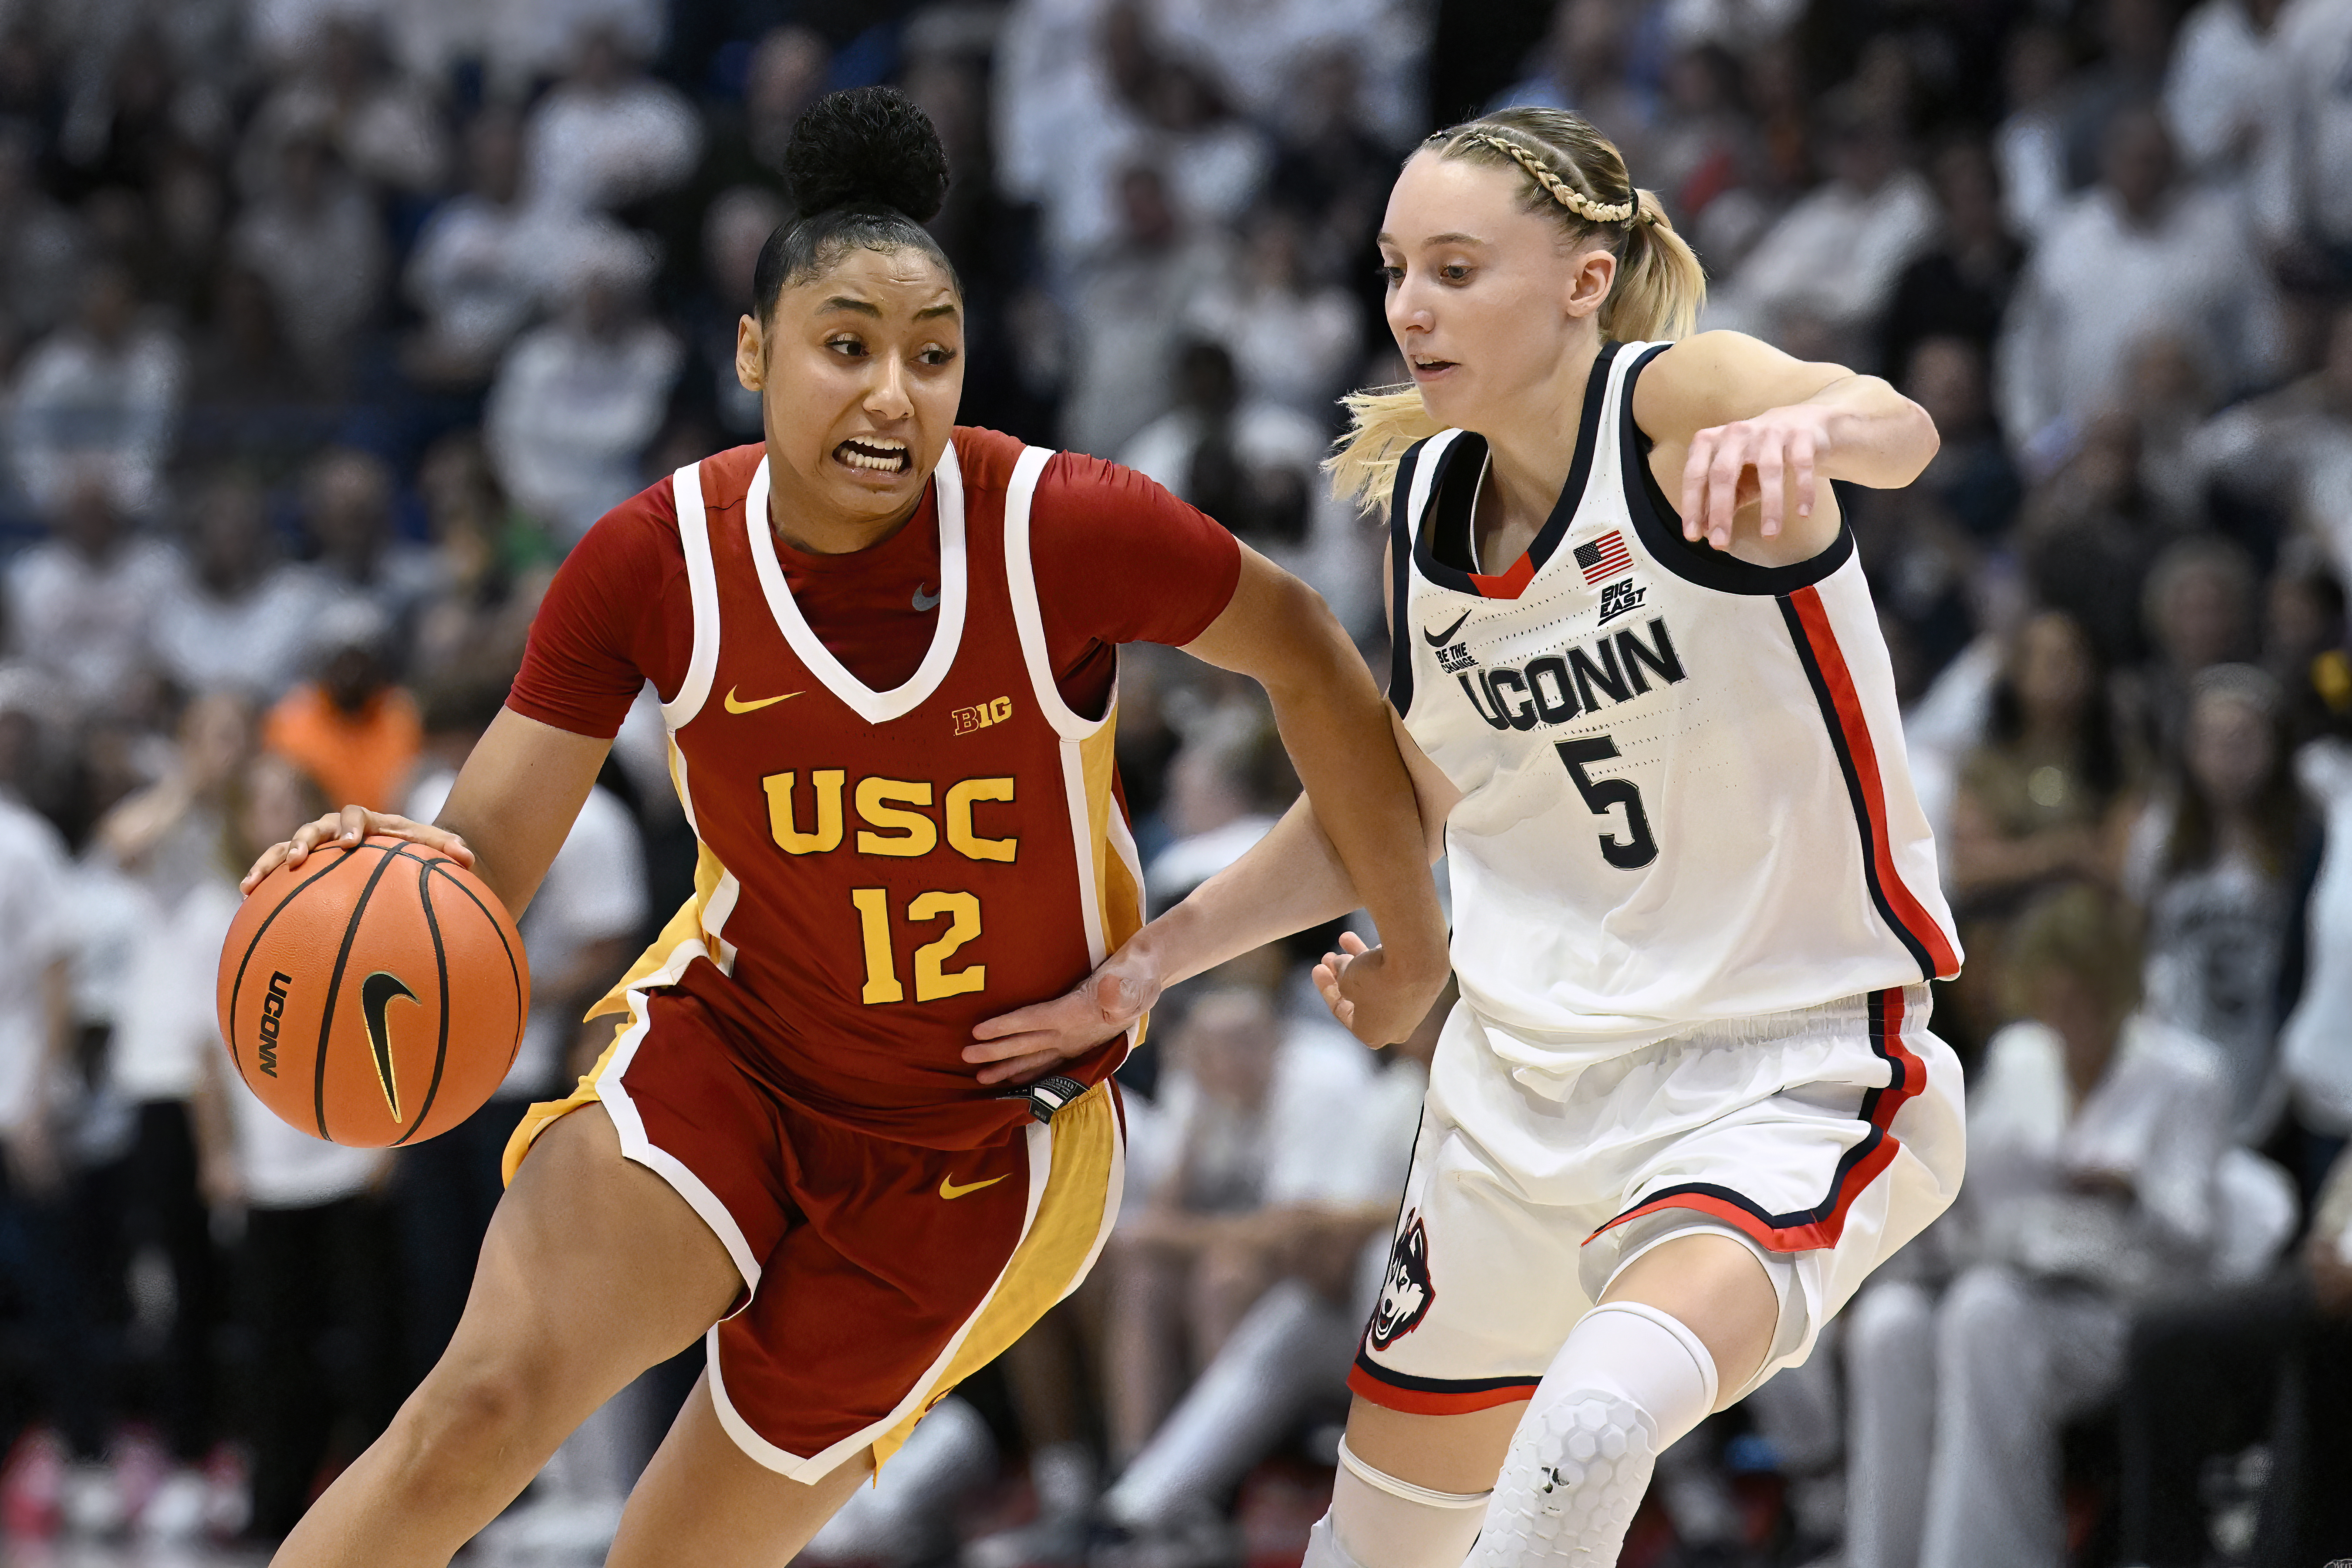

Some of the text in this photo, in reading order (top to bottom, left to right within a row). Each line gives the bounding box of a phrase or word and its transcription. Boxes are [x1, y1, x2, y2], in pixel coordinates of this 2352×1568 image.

[1600, 587, 1646, 618] EAST
[1602, 577, 1633, 604] BIG
[1435, 642, 1468, 663] BE THE
[1441, 656, 1480, 674] CHANGE
[1456, 615, 1688, 732] UCONN
[761, 768, 1018, 863] USC
[1554, 733, 1659, 871] 5
[851, 887, 986, 1005] 12
[259, 970, 292, 1078] UCONN
